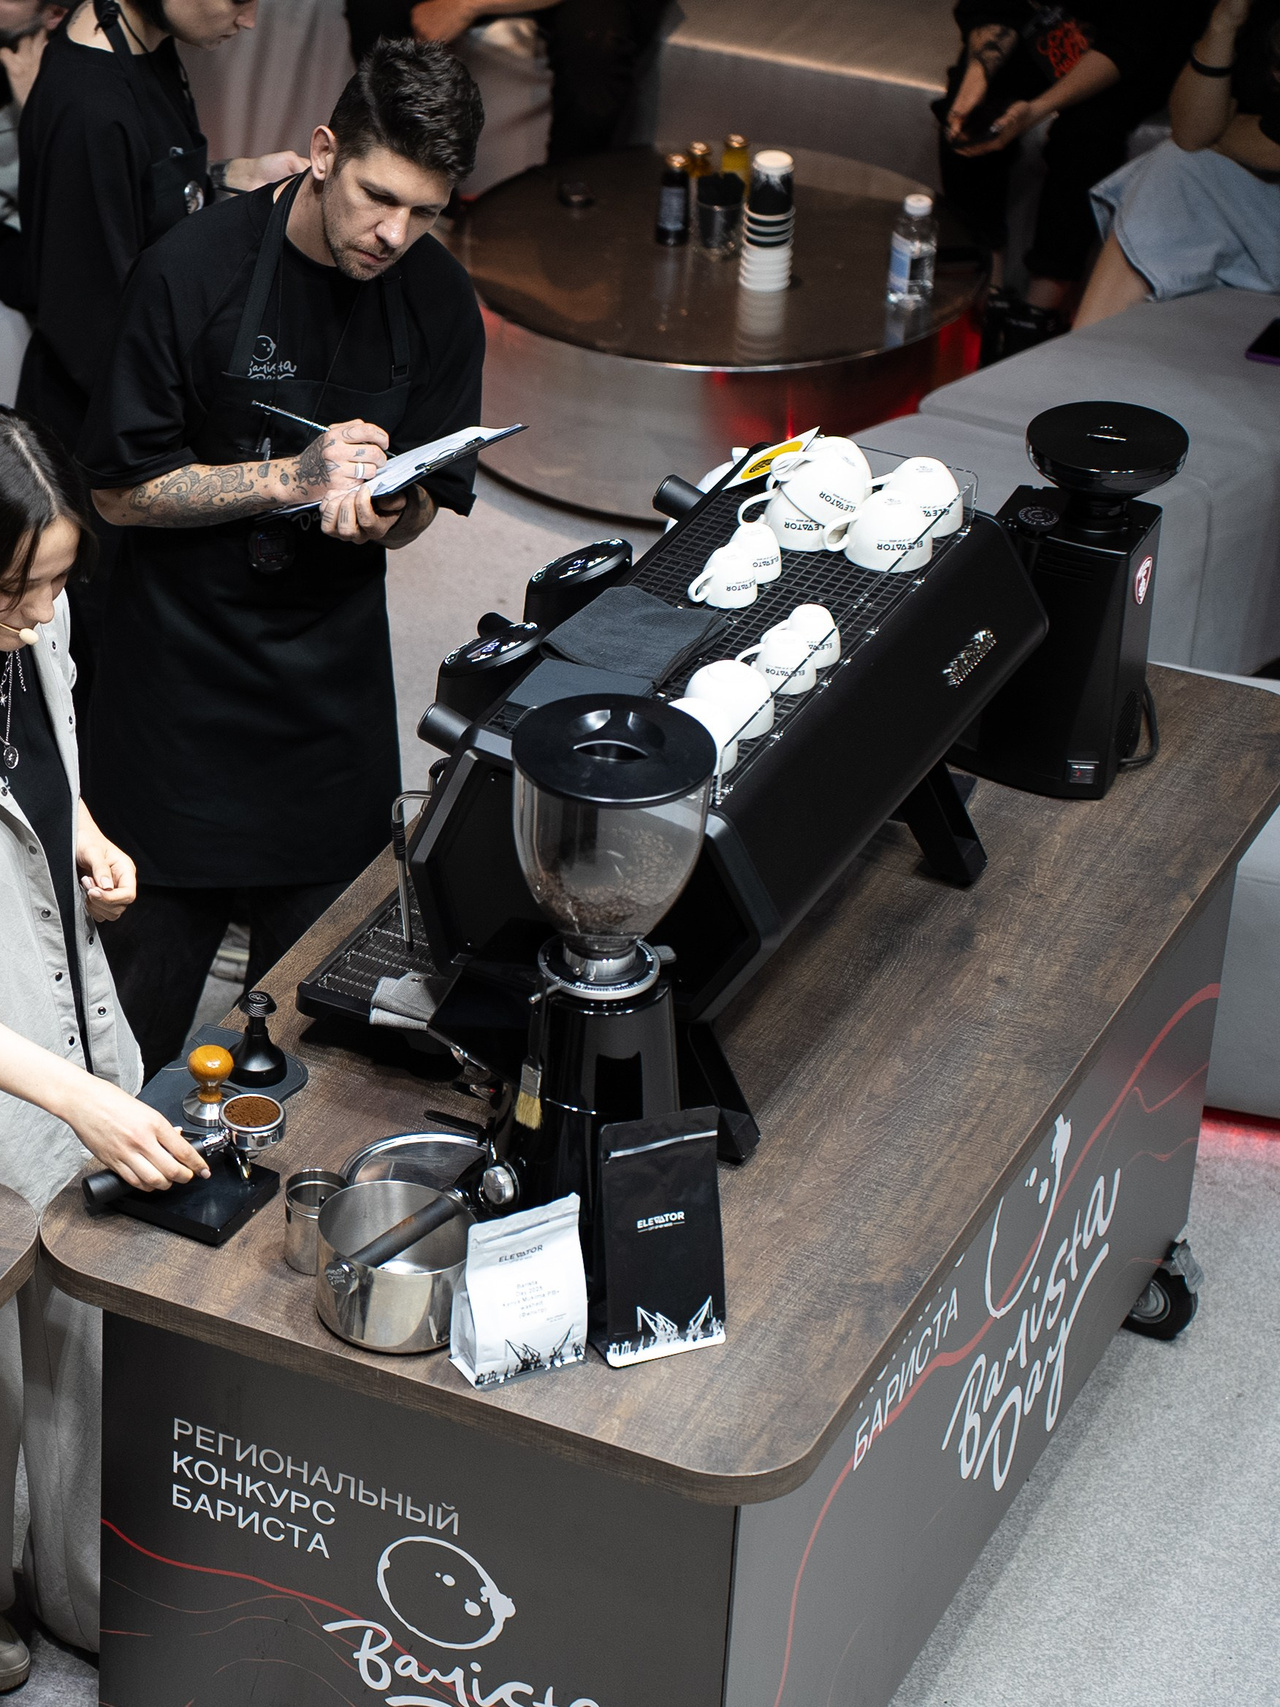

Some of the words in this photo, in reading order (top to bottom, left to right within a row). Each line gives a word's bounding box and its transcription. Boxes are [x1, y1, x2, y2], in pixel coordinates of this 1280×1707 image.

[819, 490, 856, 513] ELEVATOR
[498, 1244, 543, 1263] ELEVATOR
[636, 1211, 685, 1229] ELEVATOR
[941, 1167, 1121, 1480] Barista
[853, 1287, 959, 1471] БАРИСТА
[972, 1242, 1110, 1492] Day
[172, 1450, 337, 1526] КОНКУРС
[173, 1417, 460, 1536] РЕГИОНАЛЬНЫЙ
[172, 1483, 331, 1560] БАРИСТА
